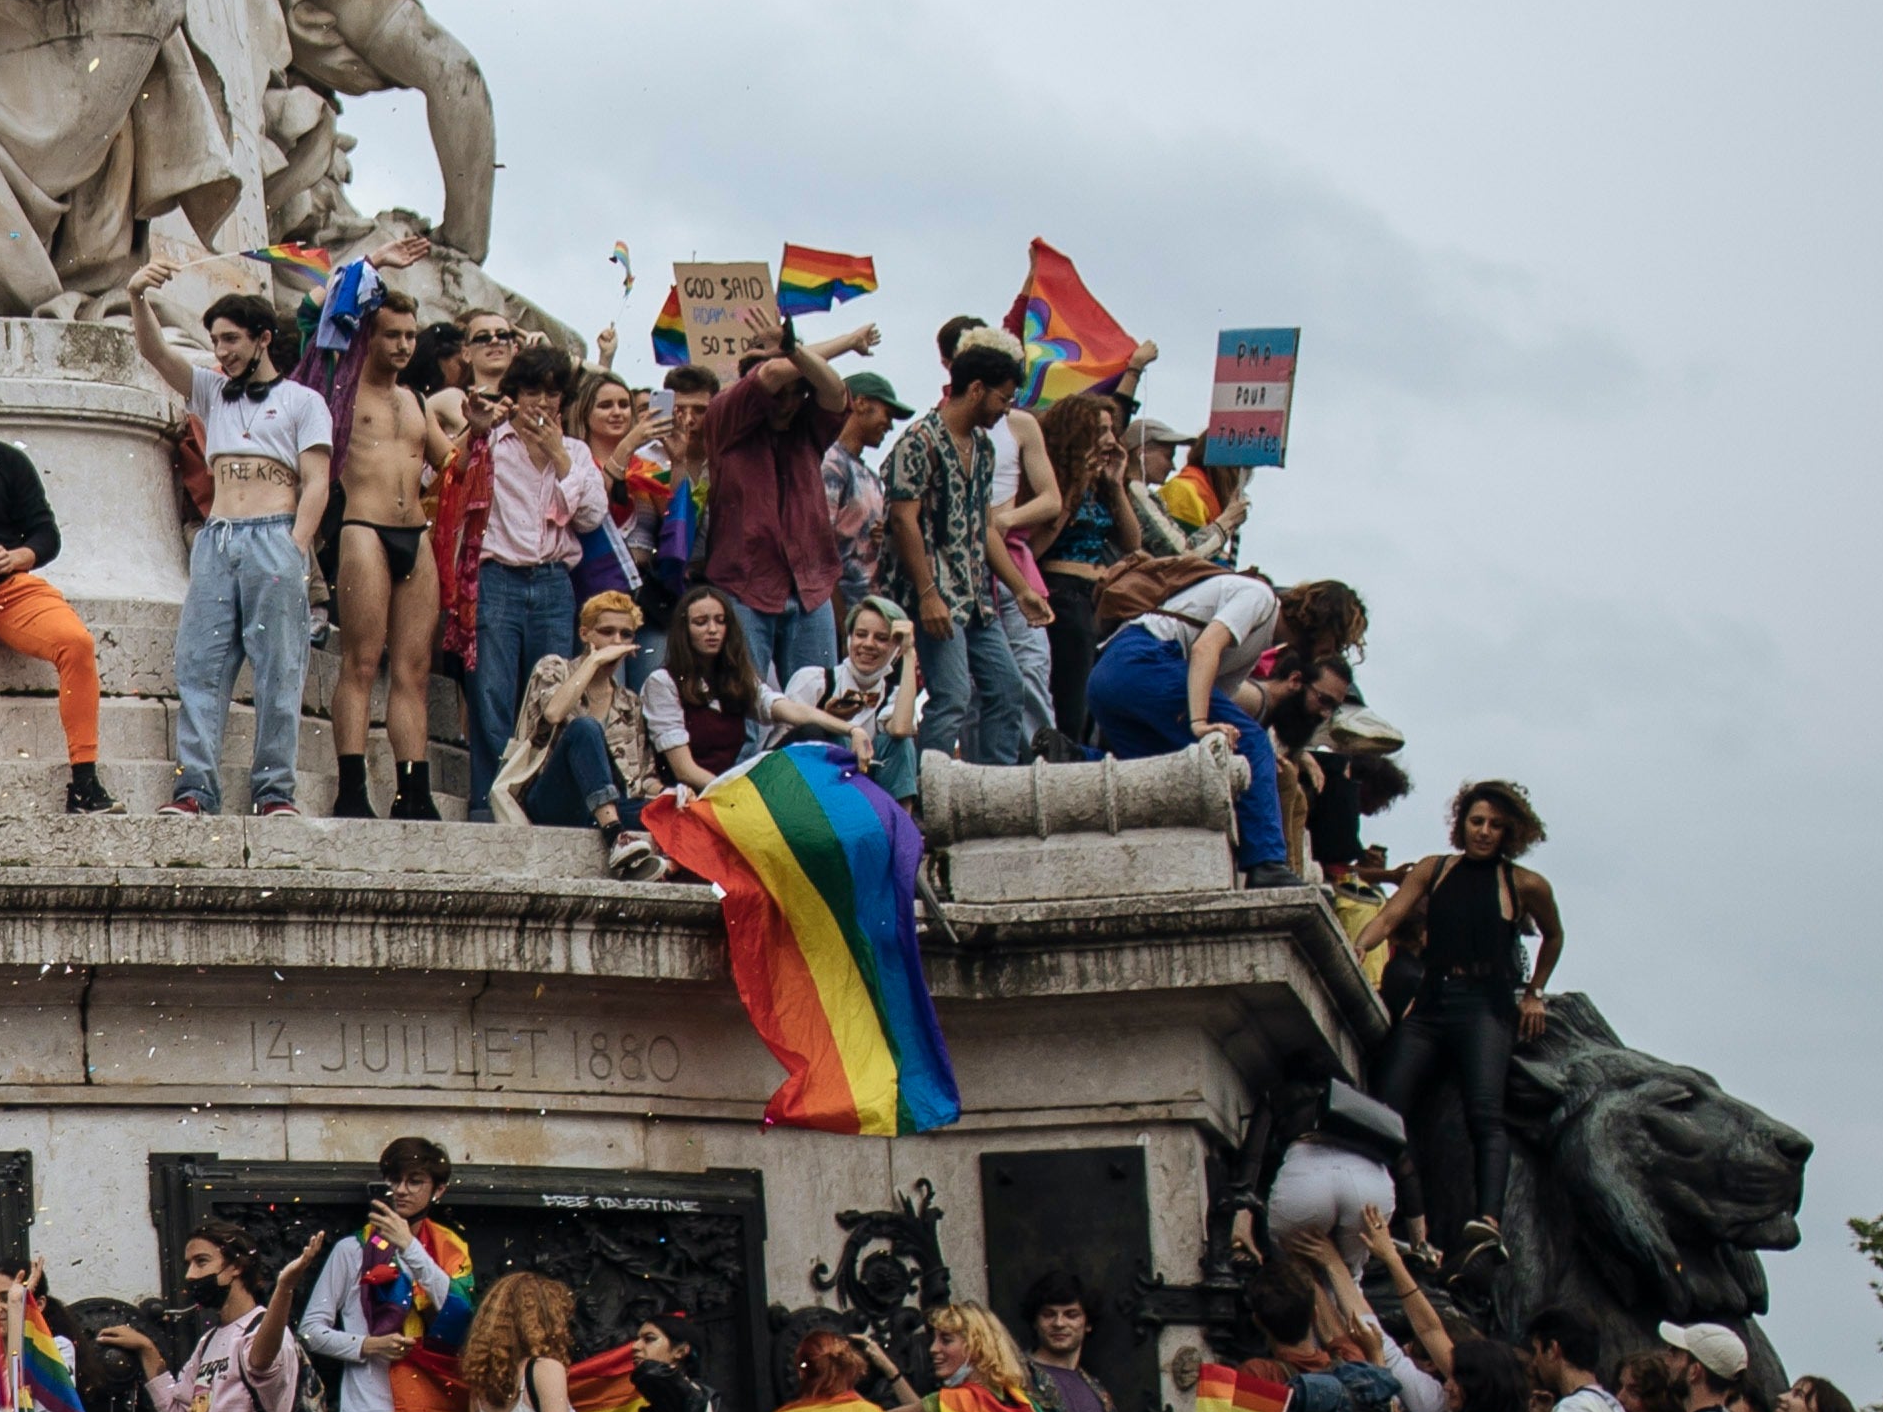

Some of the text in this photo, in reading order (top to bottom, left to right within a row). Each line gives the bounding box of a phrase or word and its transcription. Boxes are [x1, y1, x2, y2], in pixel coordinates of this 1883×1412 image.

[684, 276, 764, 300] GOD SAID
[701, 336, 720, 355] SO
[724, 339, 736, 355] I
[1237, 343, 1271, 368] PMA
[1235, 386, 1265, 405] POUR
[220, 462, 251, 485] FREE
[251, 1021, 682, 1082] 14 JUILLET 1880
[541, 1194, 702, 1212] FREE PALESTINE
